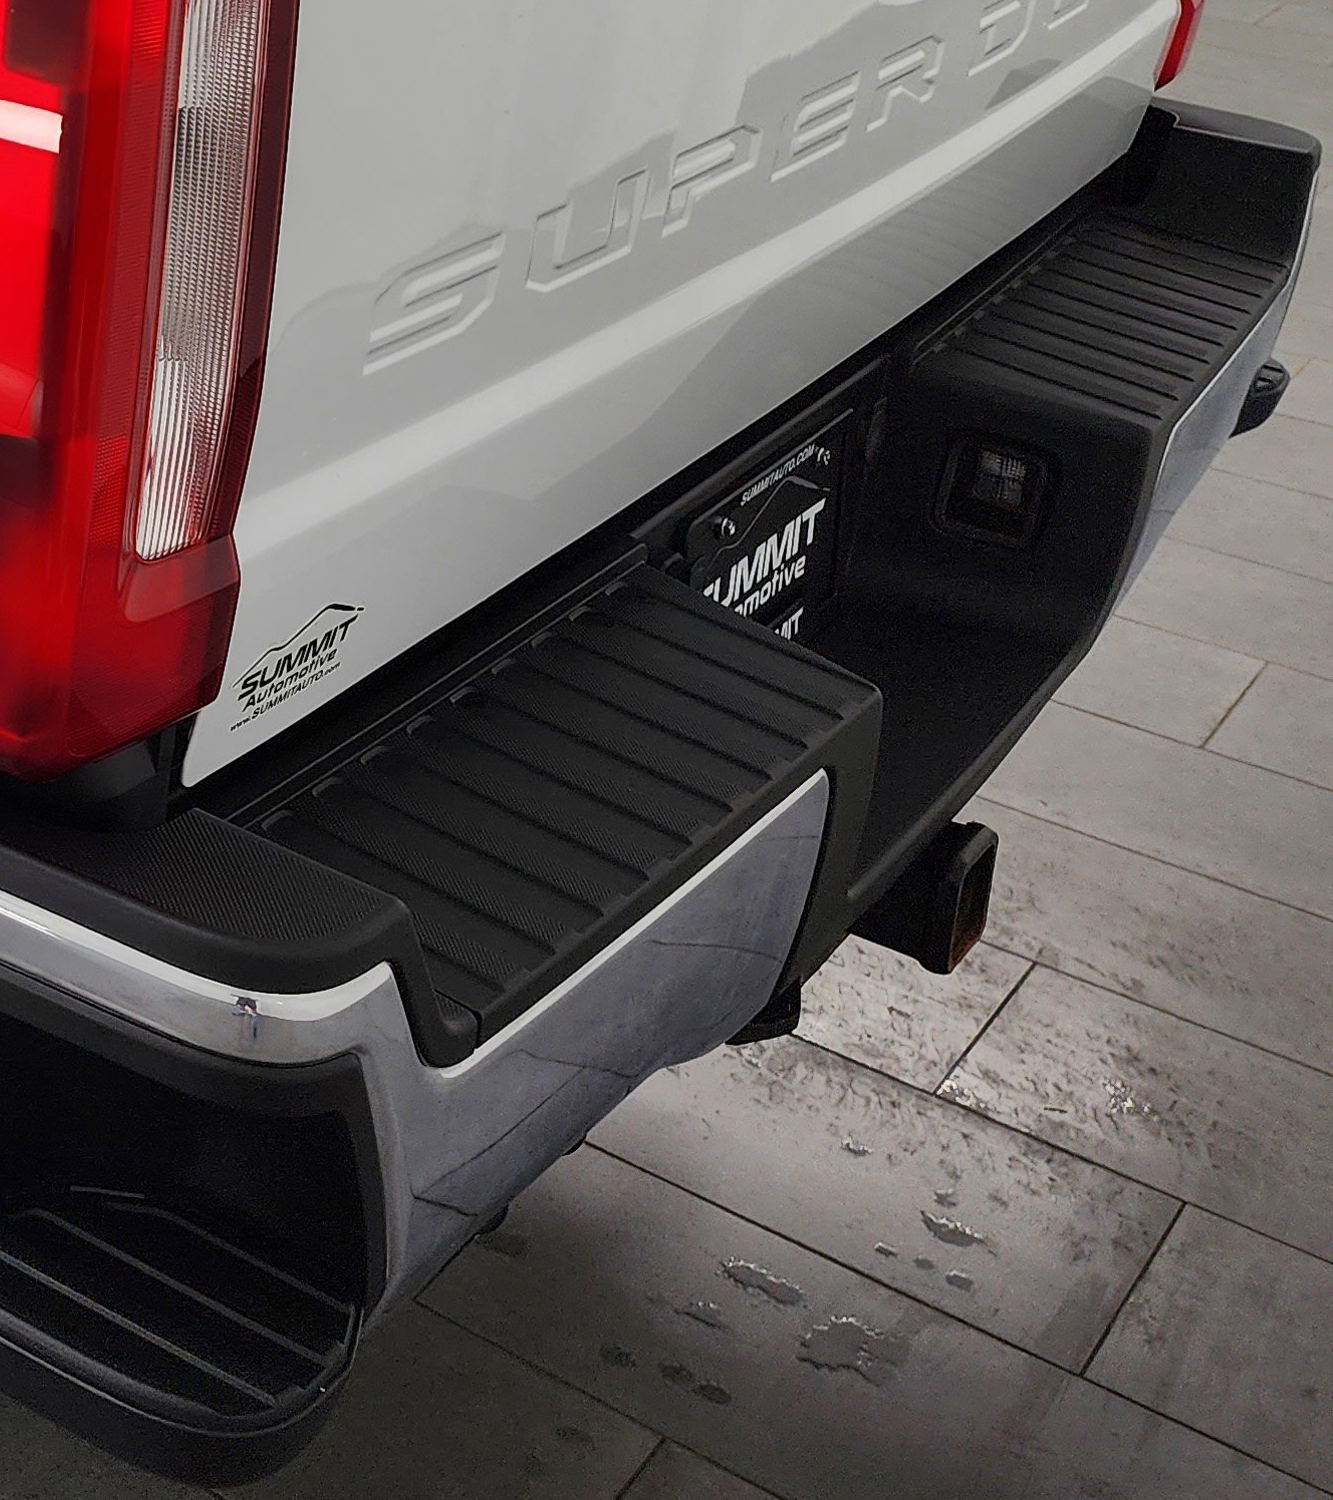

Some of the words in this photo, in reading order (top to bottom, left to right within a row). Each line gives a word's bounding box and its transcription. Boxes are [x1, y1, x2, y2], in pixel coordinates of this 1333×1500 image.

[362, 34, 946, 377] SUPER
[740, 444, 817, 506] SUMMITAUTO.COM
[238, 614, 358, 701] SUMMIT
[242, 648, 337, 713] Automotive
